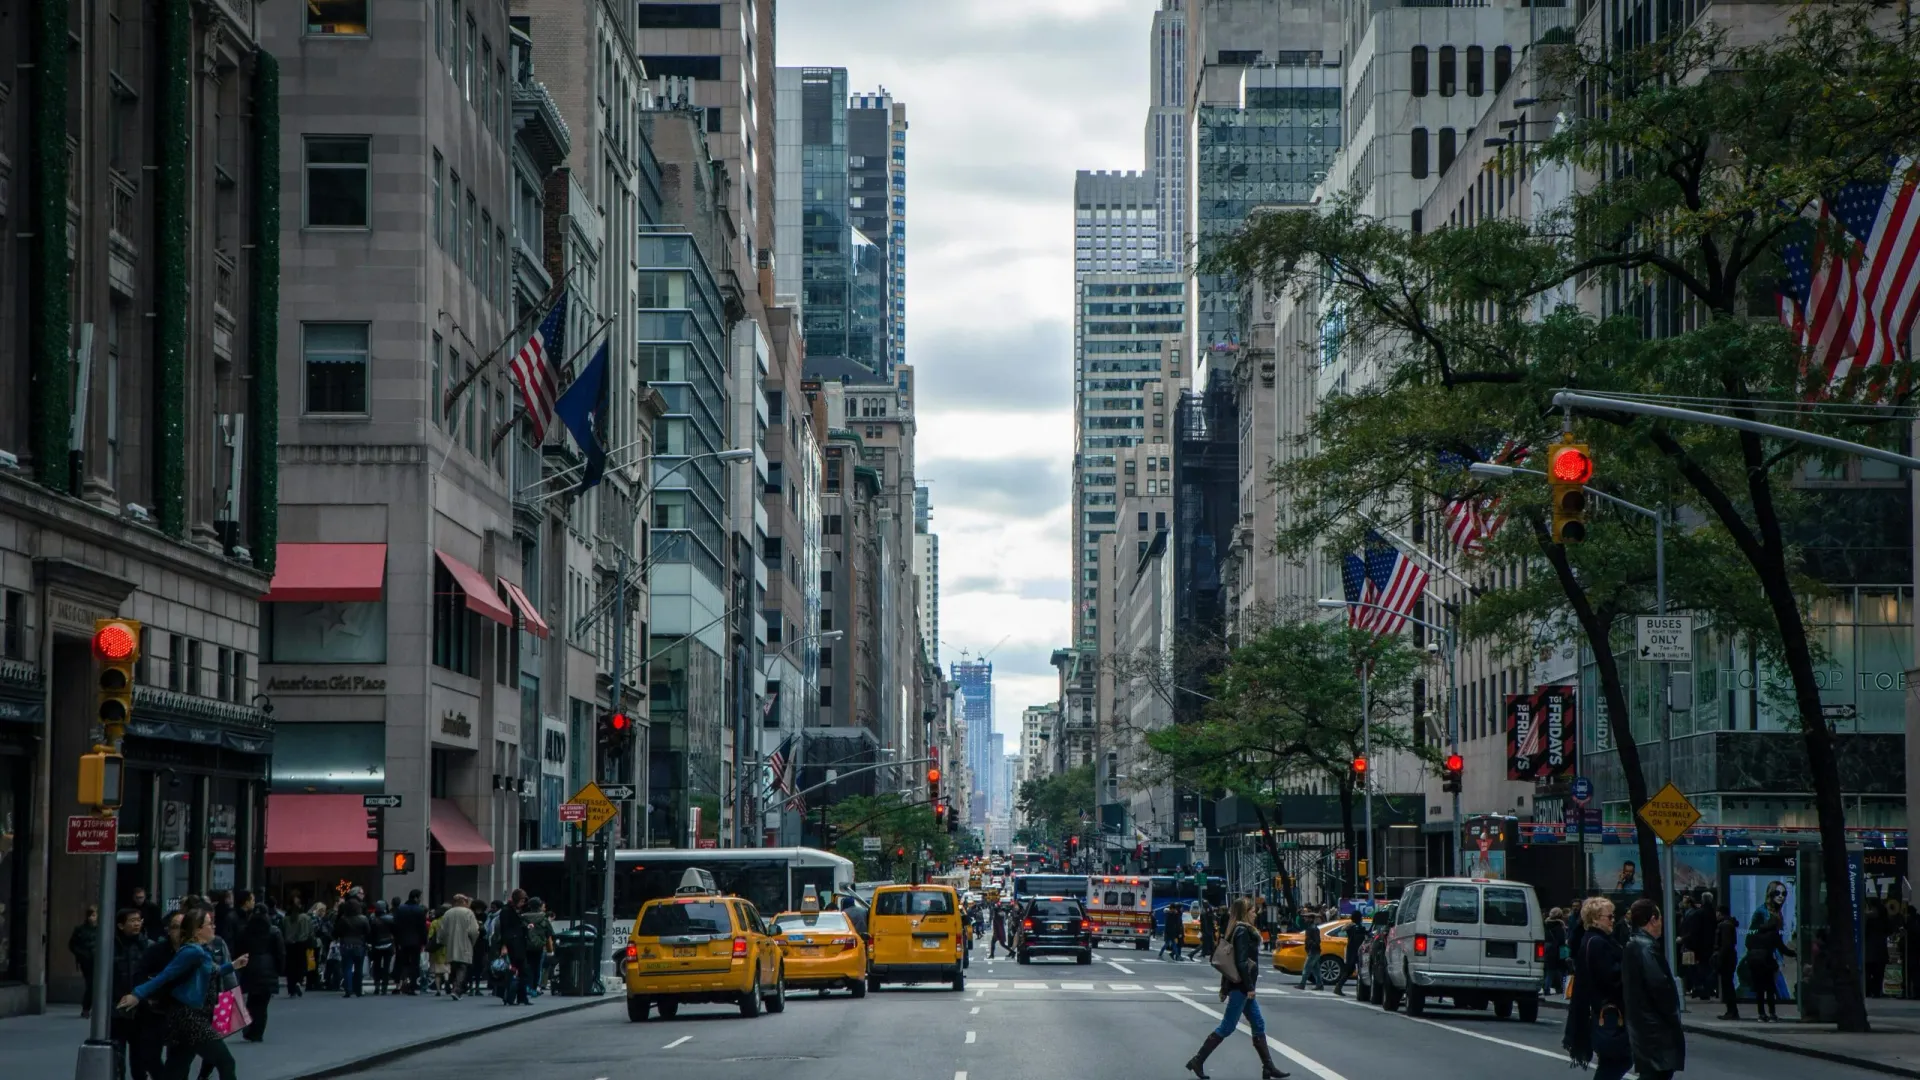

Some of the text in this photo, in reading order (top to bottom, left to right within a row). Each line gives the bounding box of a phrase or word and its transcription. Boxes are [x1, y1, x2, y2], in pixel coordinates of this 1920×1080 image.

[1647, 619, 1682, 629] BUSES
[1651, 635, 1678, 644] ONLY
[266, 675, 387, 691] American Girl Place
[1721, 670, 1844, 690] TOPSOP
[1549, 704, 1563, 767] FRIDAYS
[615, 787, 629, 795] WAY
[1648, 810, 1692, 818] CROSSWALK
[72, 820, 115, 828] NO STOPPING
[76, 830, 108, 839] ANYTIME
